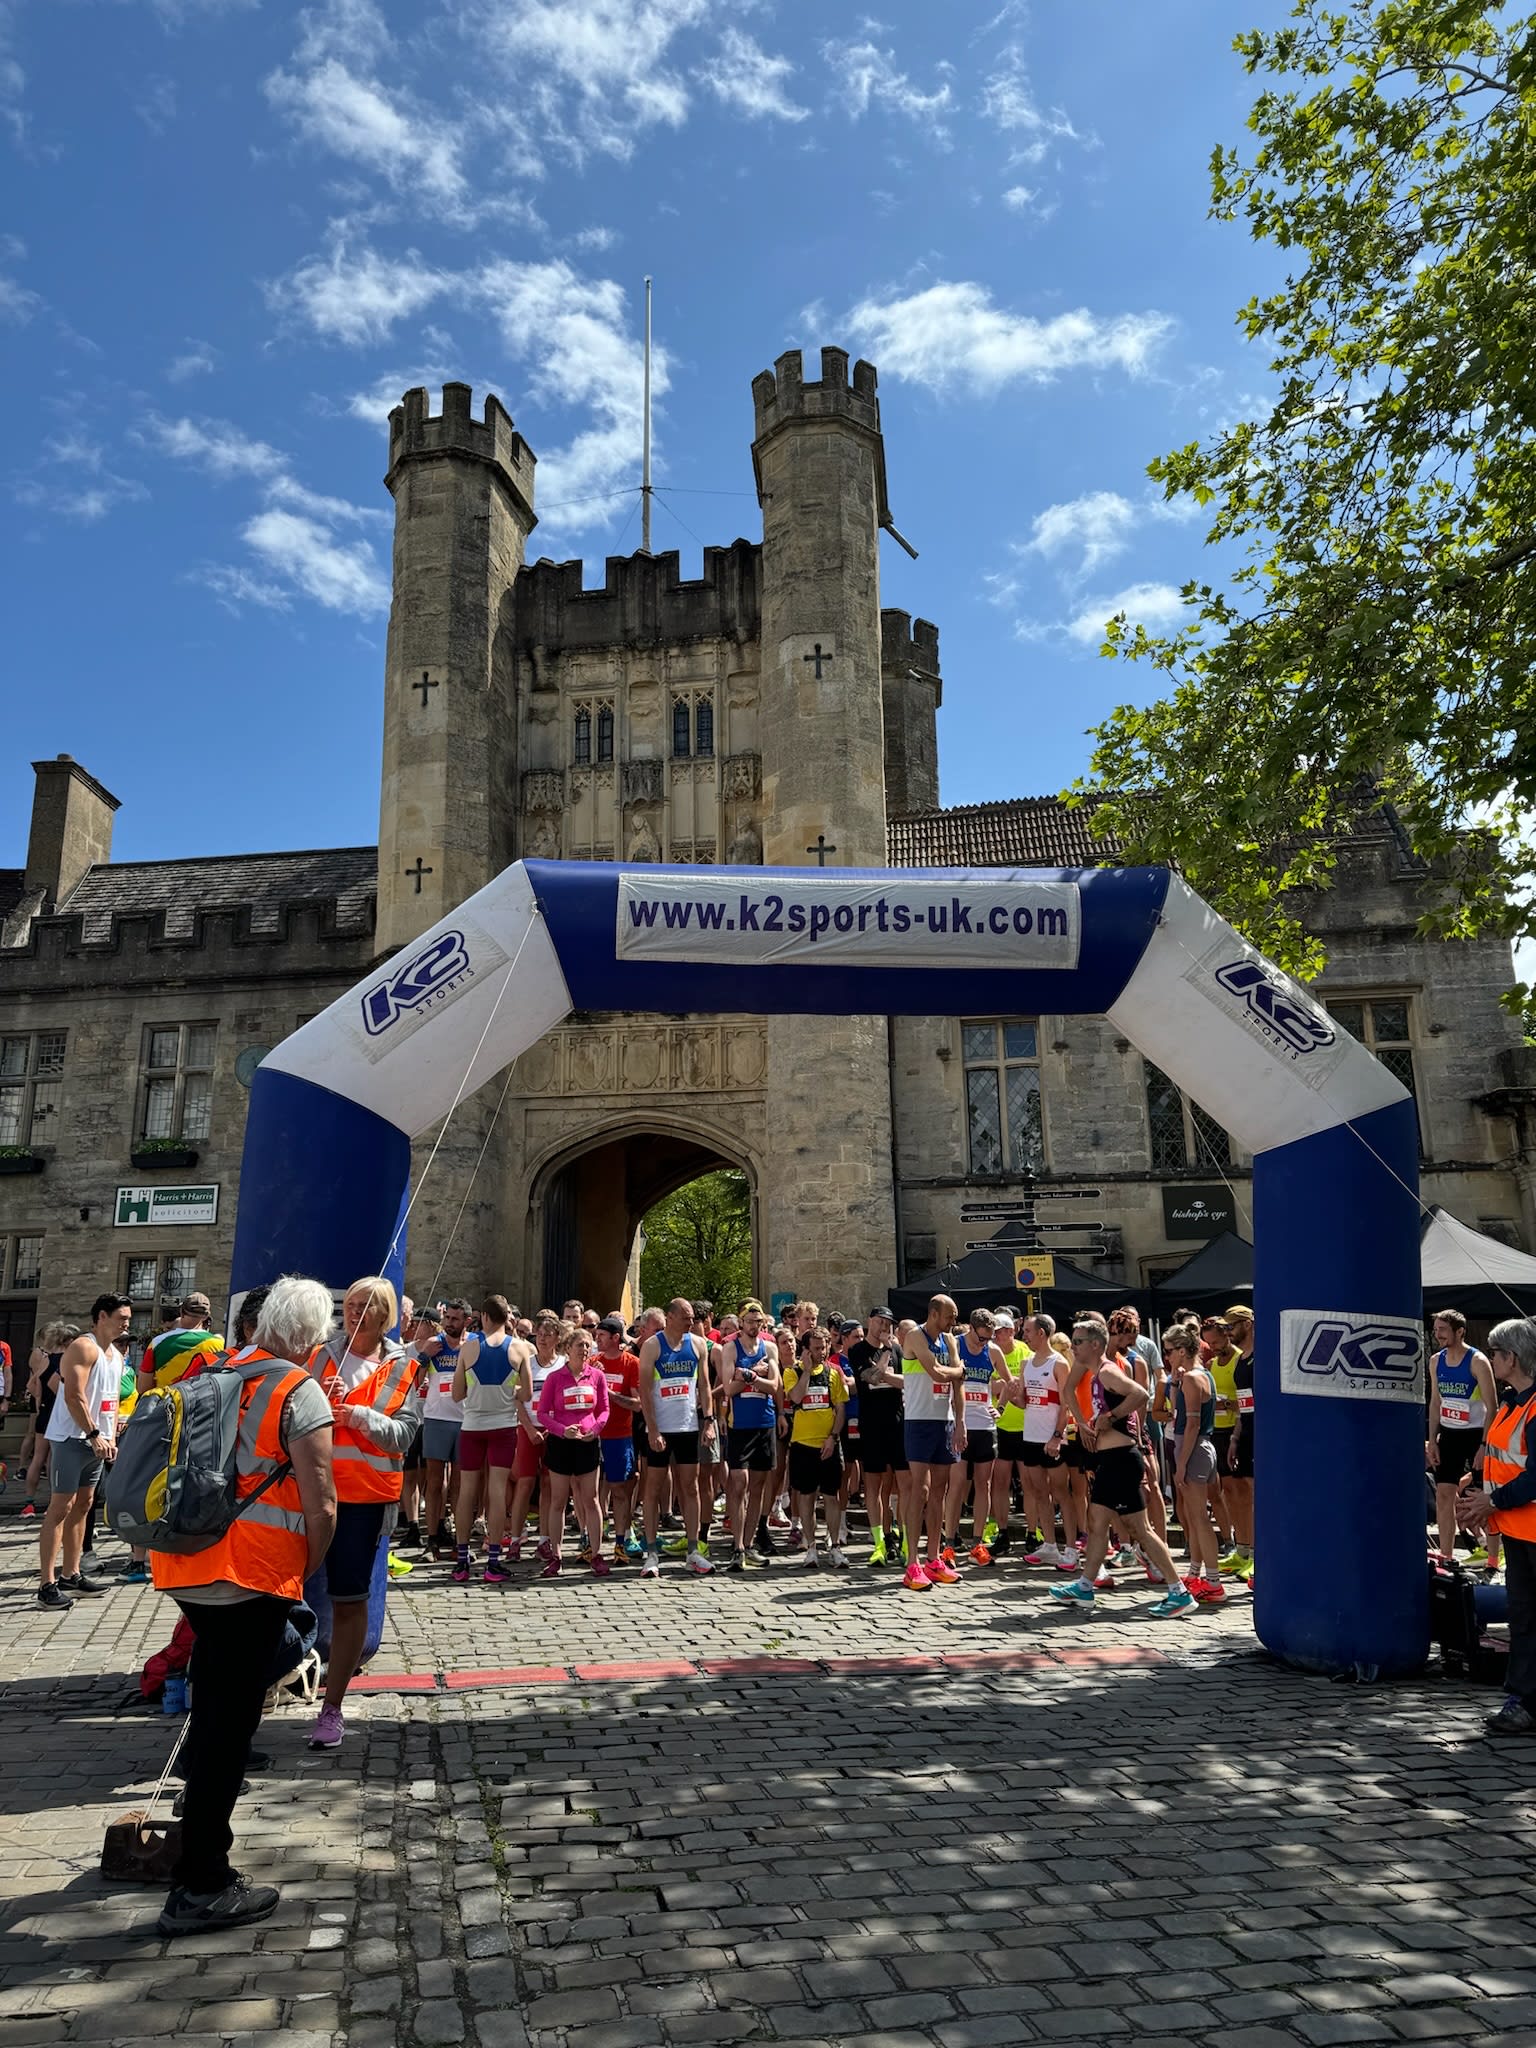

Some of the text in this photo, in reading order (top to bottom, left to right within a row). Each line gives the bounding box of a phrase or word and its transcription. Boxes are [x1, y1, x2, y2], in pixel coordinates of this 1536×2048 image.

[629, 894, 1068, 941] www.k2sports-uk.com
[362, 930, 469, 1035] K2
[416, 968, 475, 1015] SPORTS
[1215, 960, 1335, 1053] K2
[1243, 1010, 1299, 1060] SPORTS
[154, 1193, 179, 1202] Harris
[188, 1191, 213, 1201] Harris
[155, 1208, 210, 1217] solicitors
[1172, 1209, 1228, 1221] bishop's eye
[1298, 1320, 1422, 1381] K2
[661, 1359, 695, 1368] WELLS CITY
[669, 1386, 683, 1395] 177
[1351, 1378, 1413, 1392] SPORTS
[1455, 1382, 1469, 1390] CITY
[968, 1393, 983, 1401] 113
[1446, 1409, 1461, 1419] 143
